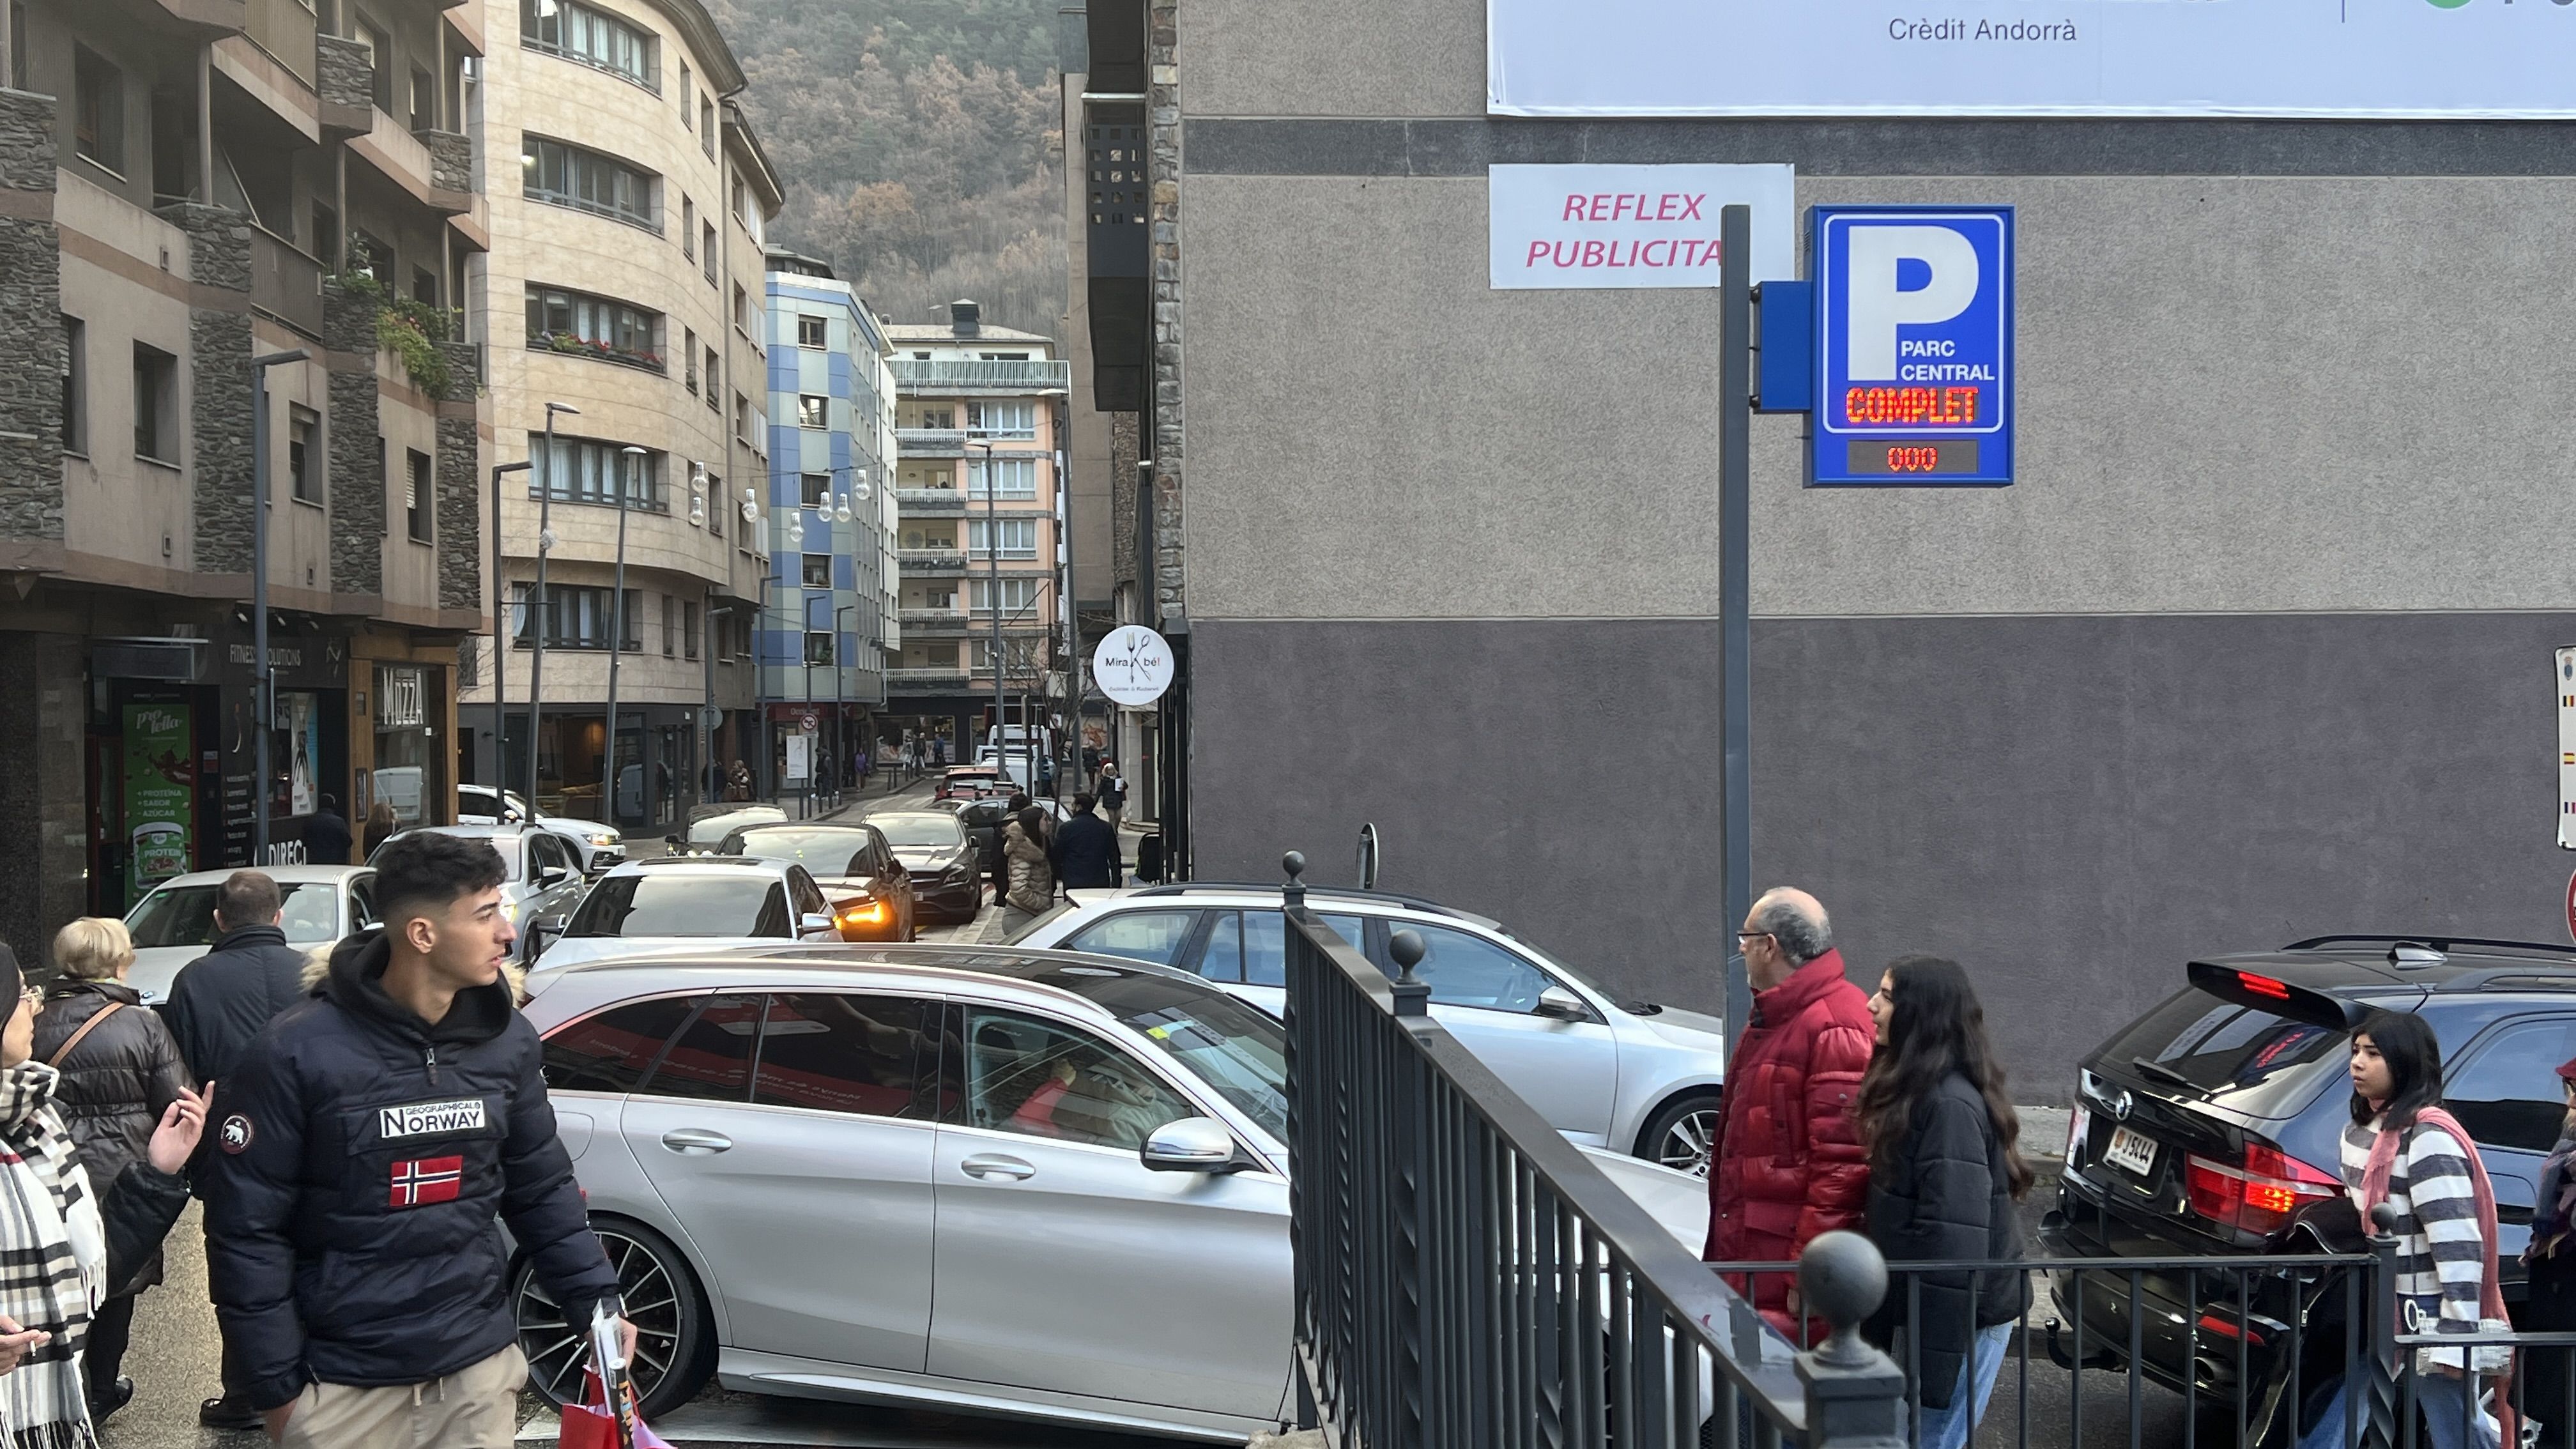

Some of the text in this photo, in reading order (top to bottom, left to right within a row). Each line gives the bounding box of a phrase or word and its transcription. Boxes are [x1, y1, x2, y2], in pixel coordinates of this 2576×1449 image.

[1889, 18, 2076, 40] Crèdit Andorrà
[1562, 194, 1707, 221] REFLEX
[1847, 225, 1979, 381] P
[1901, 340, 1956, 357] PARC
[1901, 364, 1995, 381] CENTRAL
[1846, 386, 1979, 424] COMPLET
[1887, 446, 1938, 472] 000
[267, 648, 302, 666] OLUTIONS
[1105, 657, 1129, 667] Mira
[143, 788, 182, 797] PROTEÍNA
[142, 809, 176, 818] AZÚCAR
[144, 848, 181, 858] PROTEIN
[383, 1108, 480, 1137] NORWAY
